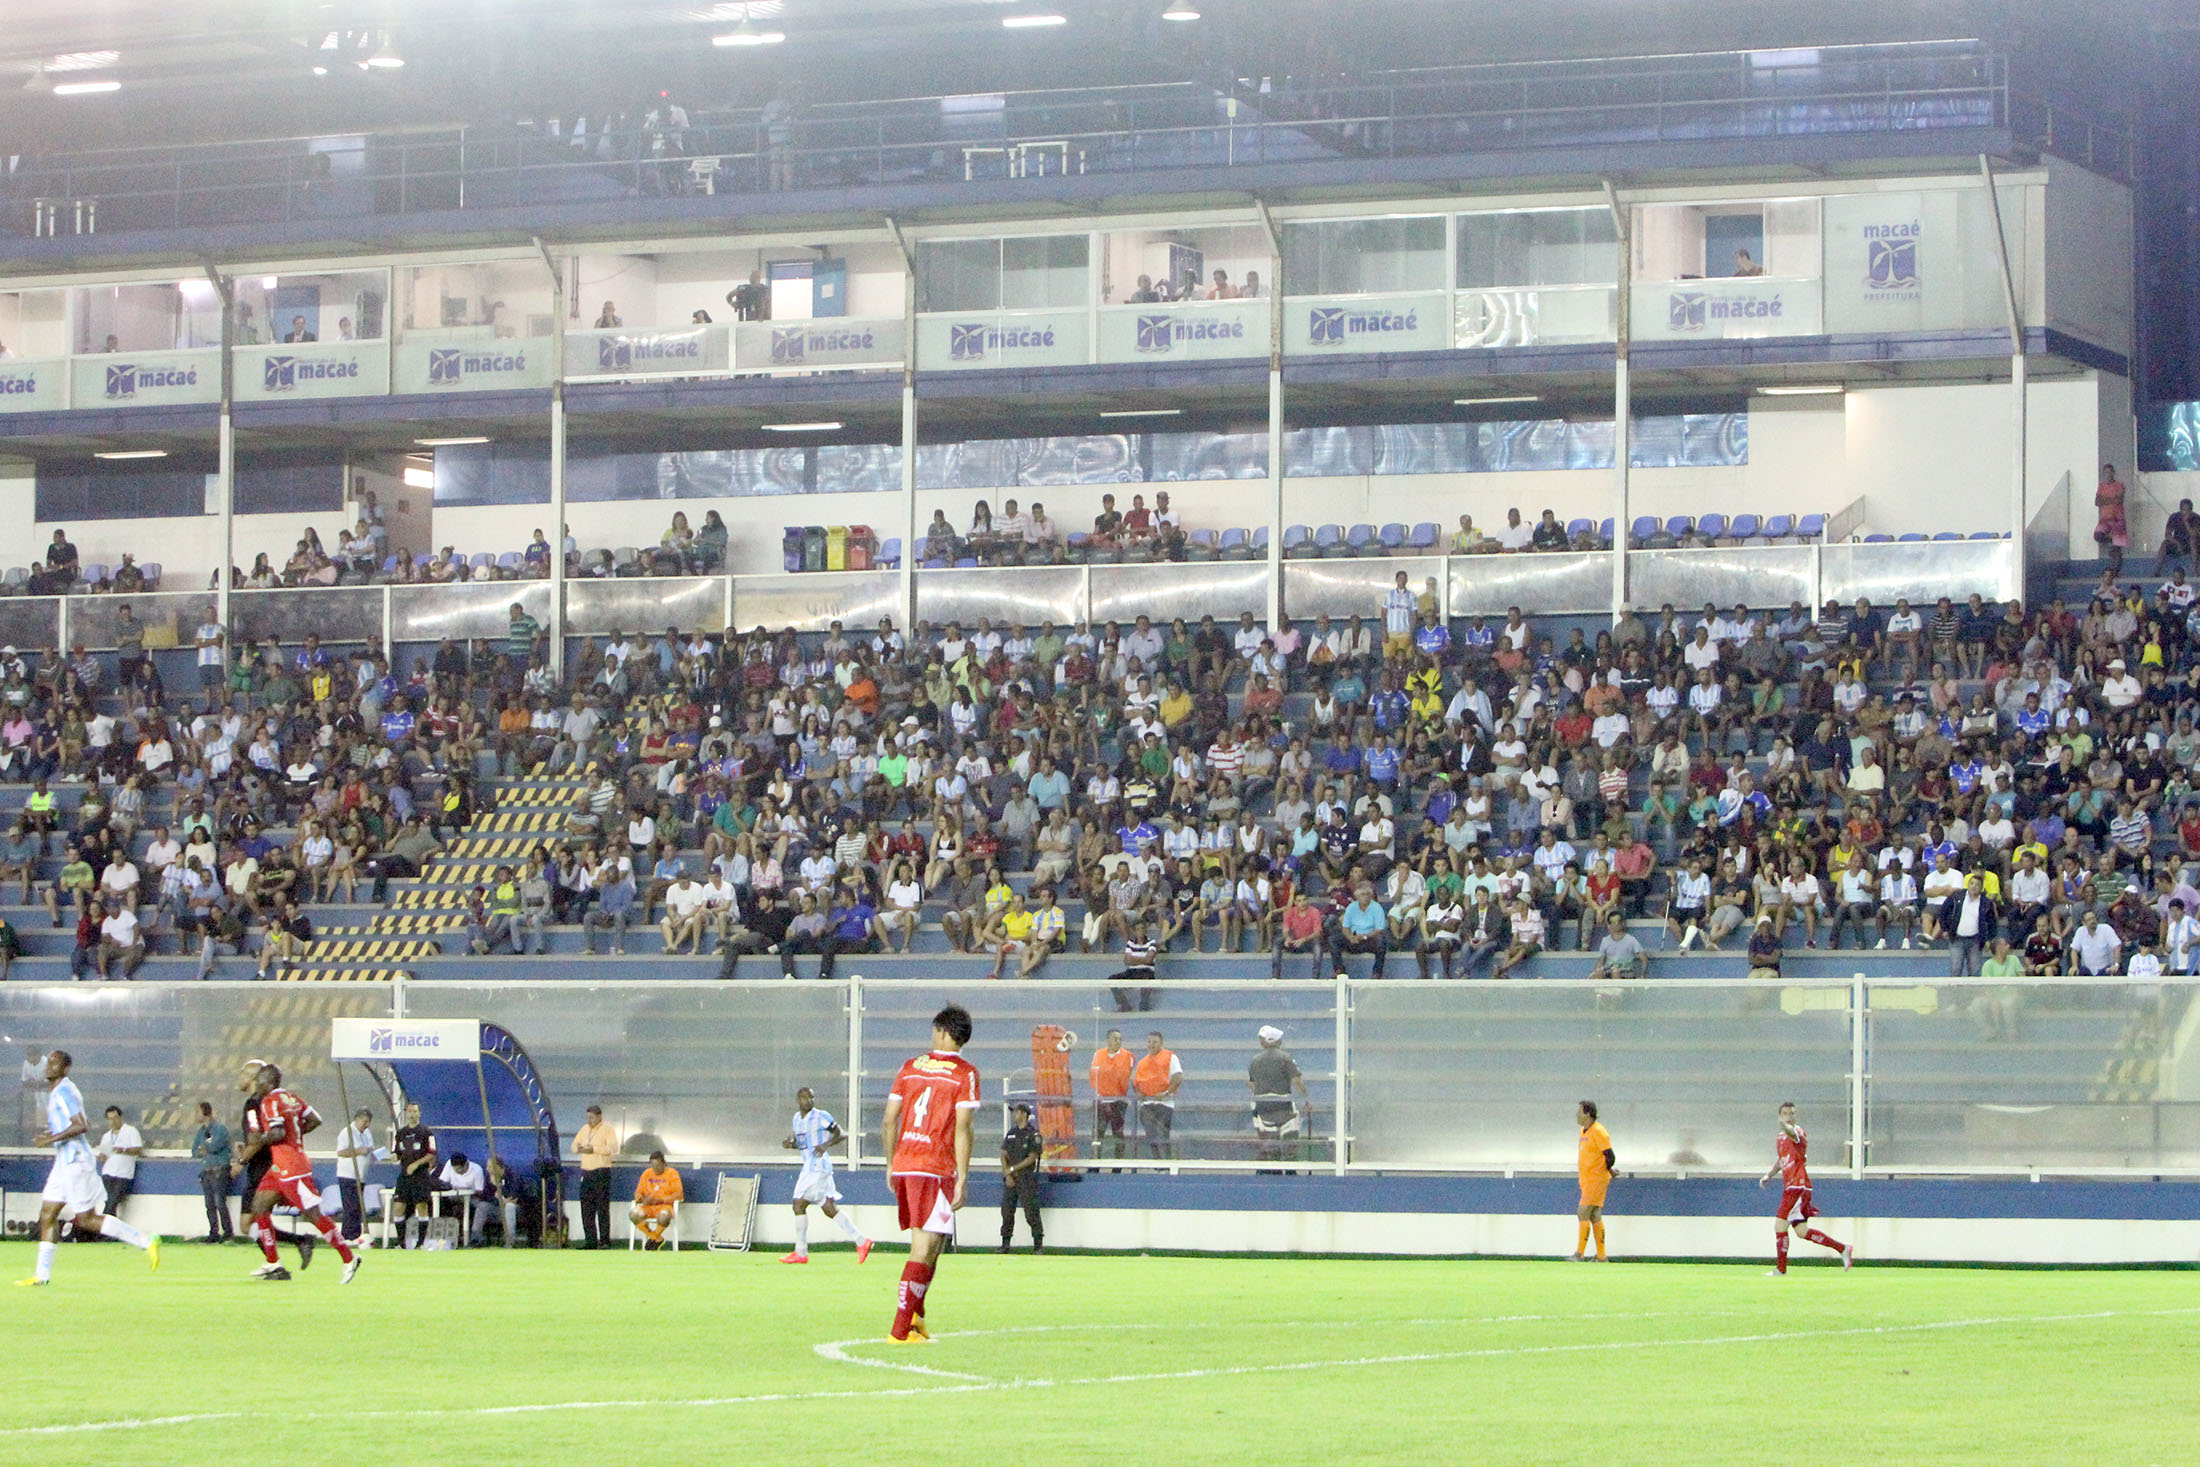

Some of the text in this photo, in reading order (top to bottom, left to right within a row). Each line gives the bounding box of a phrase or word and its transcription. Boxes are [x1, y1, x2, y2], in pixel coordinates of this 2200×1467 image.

[1863, 218, 1920, 238] macaé
[1710, 293, 1782, 318] macaé
[1863, 291, 1920, 301] PREFEITURA
[1175, 316, 1243, 340] macaé
[1348, 307, 1417, 333] macaé
[808, 328, 873, 352] macaé
[988, 324, 1054, 349] macaé
[298, 356, 359, 379] macaé
[464, 349, 526, 373] macaé
[139, 365, 197, 388] macaé
[395, 1031, 439, 1047] macaé
[914, 1087, 931, 1127] 4
